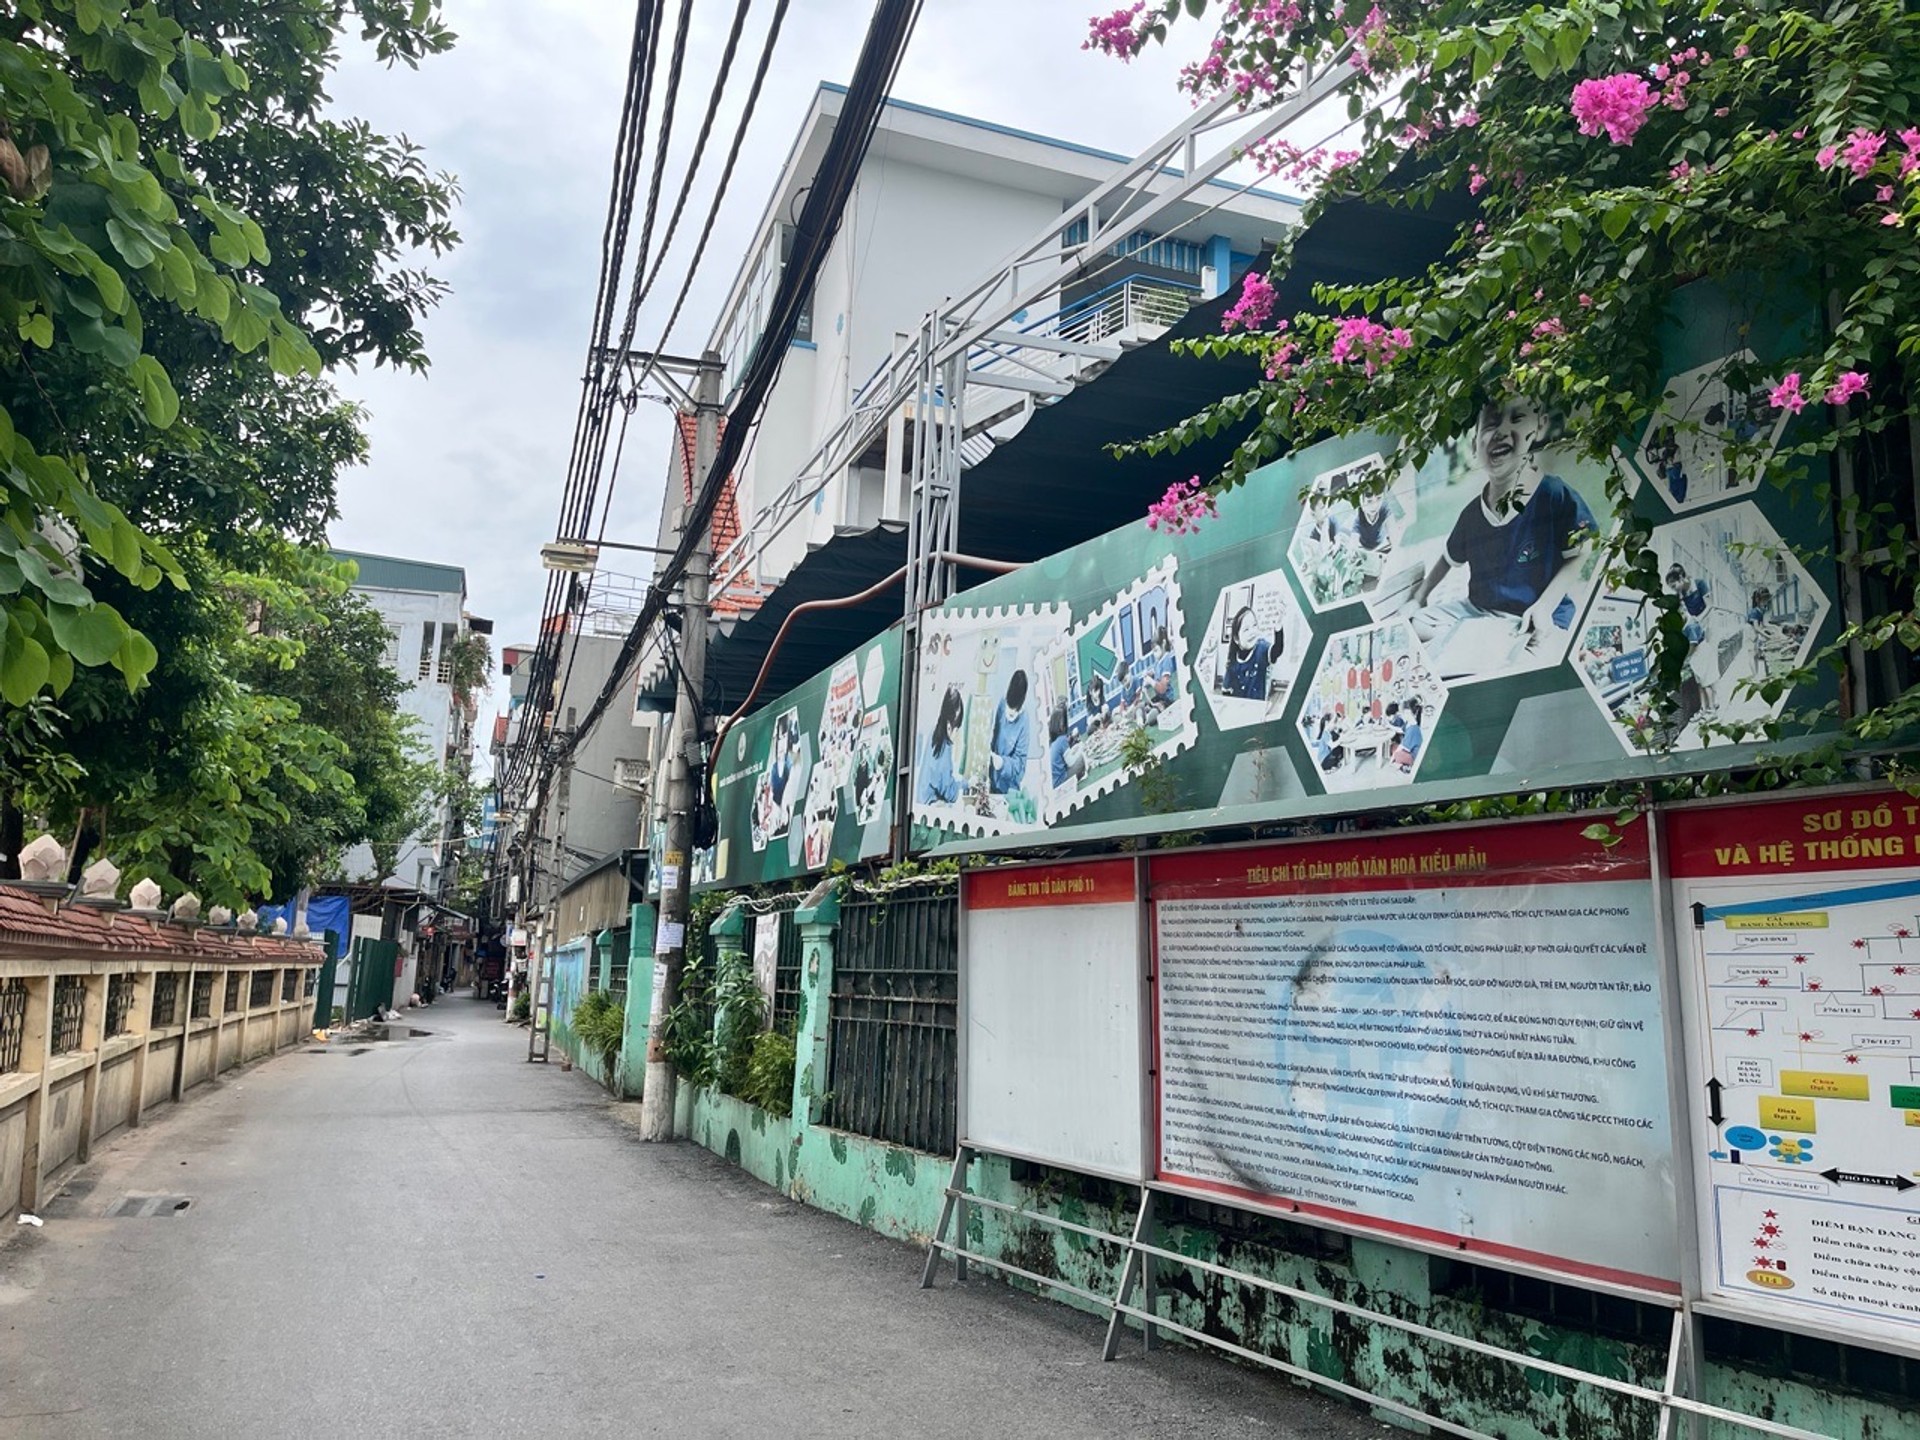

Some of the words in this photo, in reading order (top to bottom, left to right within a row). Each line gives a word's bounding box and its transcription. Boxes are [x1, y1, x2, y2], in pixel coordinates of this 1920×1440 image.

[1803, 809, 1842, 833] SƠ
[1851, 801, 1893, 829] ĐỒ
[1715, 843, 1751, 866] VÀ
[1758, 840, 1795, 866] HỆ
[1803, 832, 1905, 861] THỐNG
[1247, 863, 1268, 883] TIÊU
[1272, 861, 1290, 882] CHÍ
[1292, 858, 1306, 880] TỔ
[1309, 861, 1330, 879] DÂN
[1335, 854, 1359, 878] PHỐ
[1362, 856, 1387, 876] VĂN
[1420, 848, 1450, 873] KIỂU
[1455, 846, 1487, 872] MẪU
[1028, 882, 1039, 895] TIN
[1051, 878, 1067, 894] DÂN
[1068, 876, 1084, 893] PHỐ
[1085, 878, 1094, 892] 11
[1493, 1012, 1502, 1022] ĐỂ
[1503, 1014, 1517, 1023] RÁC
[1518, 1015, 1541, 1024] ĐÚNG
[1541, 1016, 1556, 1025] NƠI
[1557, 1017, 1574, 1026] QUY
[1599, 1018, 1615, 1028] GIỮ
[1616, 1020, 1631, 1029] GÌN
[1632, 1020, 1643, 1031] VỆ
[1492, 1030, 1508, 1040] CHỦ
[1509, 1032, 1528, 1040] NHẬT
[1529, 1033, 1551, 1043] HÀNG
[1611, 1057, 1636, 1068] CÔNG
[1452, 1078, 1461, 1088] VŨ
[1462, 1081, 1473, 1089] KHÍ
[1474, 1082, 1495, 1091] QUÂN
[1520, 1086, 1531, 1096] VŨ
[1546, 1090, 1559, 1098] SÁT
[1482, 1101, 1498, 1110] TÍCH
[1498, 1103, 1514, 1112] CỰC
[1514, 1105, 1537, 1114] THAM
[1552, 1108, 1575, 1120] CÔNG
[1576, 1112, 1590, 1121] TÁC
[1591, 1114, 1611, 1124] PCCC
[1612, 1116, 1635, 1127] THEO
[1636, 1118, 1653, 1129] CÁC
[1464, 1133, 1481, 1143] TRÊN
[1511, 1140, 1526, 1150] CỘT
[1527, 1142, 1545, 1153] ĐIỆN
[1546, 1145, 1573, 1157] TRONG
[1574, 1149, 1589, 1159] CÁC
[1474, 1152, 1489, 1162] CẢN
[1490, 1155, 1505, 1165] TRỞ
[1505, 1157, 1524, 1168] GIAO
[1473, 1171, 1494, 1181] NHÂN
[1495, 1173, 1517, 1184] PHẨM
[1518, 1178, 1544, 1189] NGƯỜI
